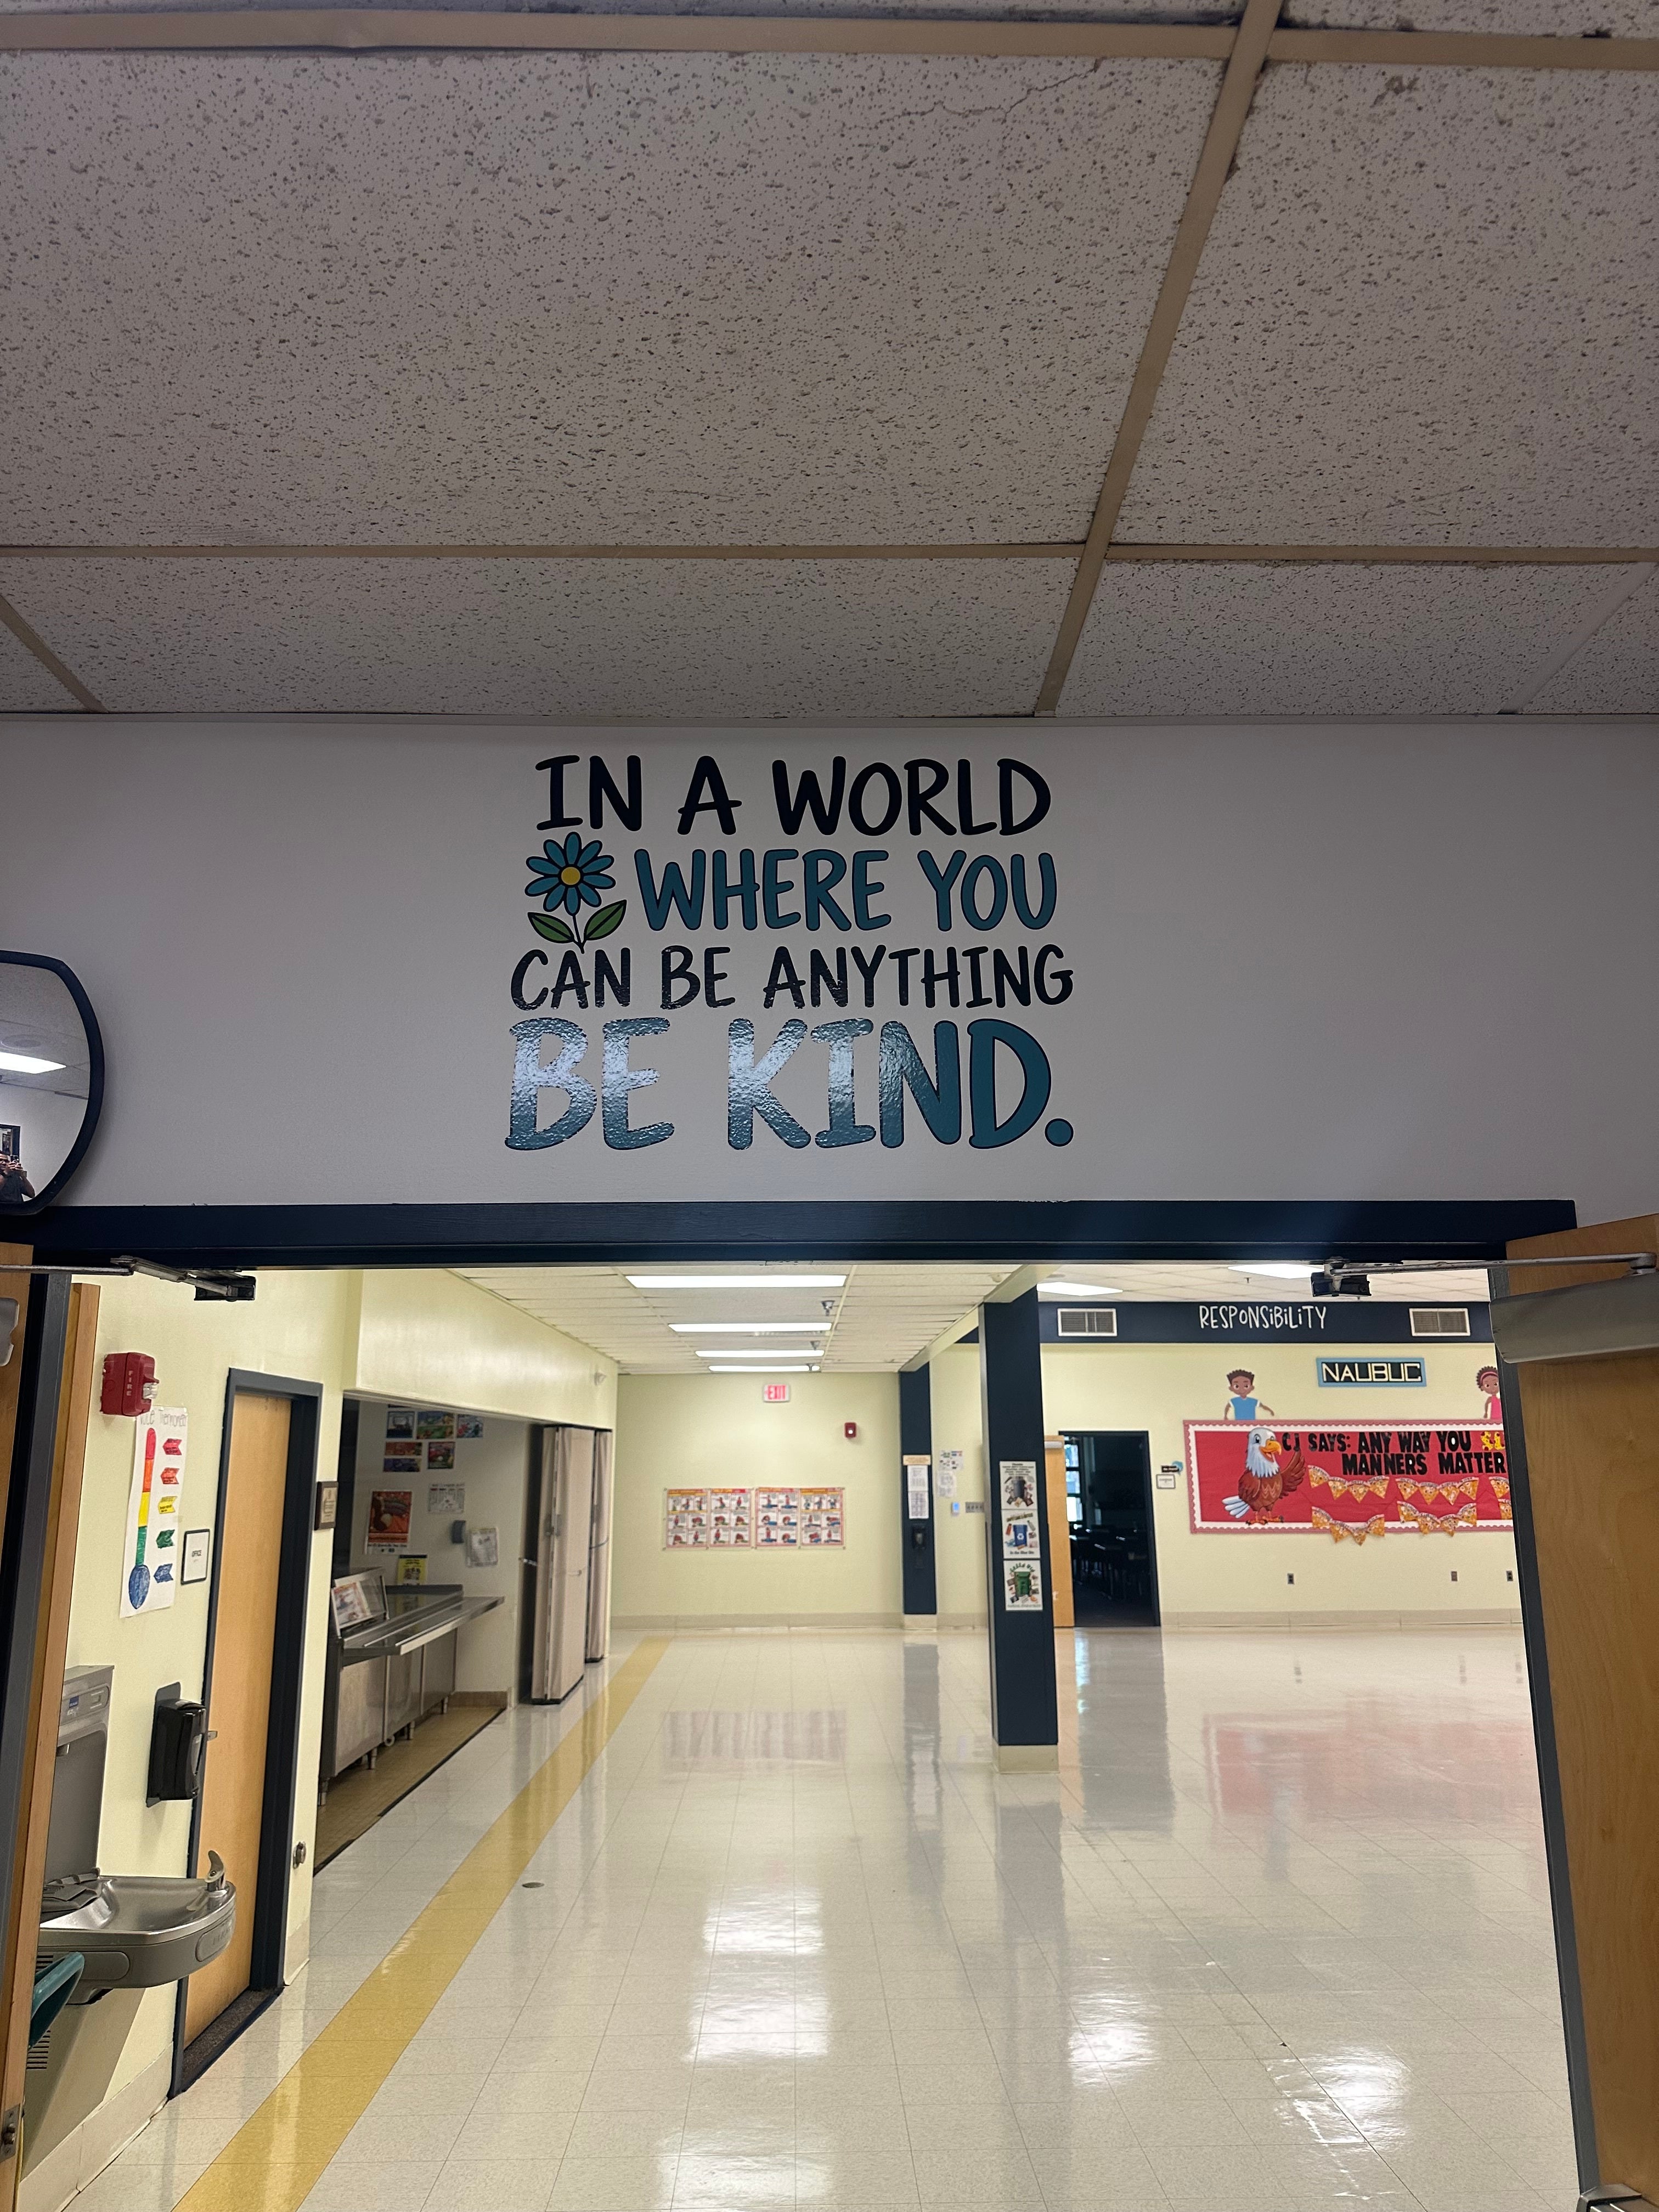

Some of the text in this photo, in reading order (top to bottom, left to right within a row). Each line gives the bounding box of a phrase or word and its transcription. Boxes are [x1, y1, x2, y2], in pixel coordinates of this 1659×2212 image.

[535, 755, 1051, 836] IN A WORLD
[634, 848, 1057, 932] WHERE YOU
[510, 944, 1074, 1010] CAN BE ANYTHING
[504, 1017, 1074, 1151] BE KIND.
[768, 1385, 786, 1400] EXIT
[1322, 1363, 1421, 1381] NAUBUC
[1282, 1432, 1300, 1452] CJ
[1308, 1433, 1351, 1452] SAYS:
[1358, 1431, 1392, 1453] ANY
[1397, 1431, 1431, 1453] WAY
[1436, 1431, 1471, 1452] YOU
[1342, 1453, 1427, 1475] MANNERS
[1437, 1452, 1506, 1474] MATTER
